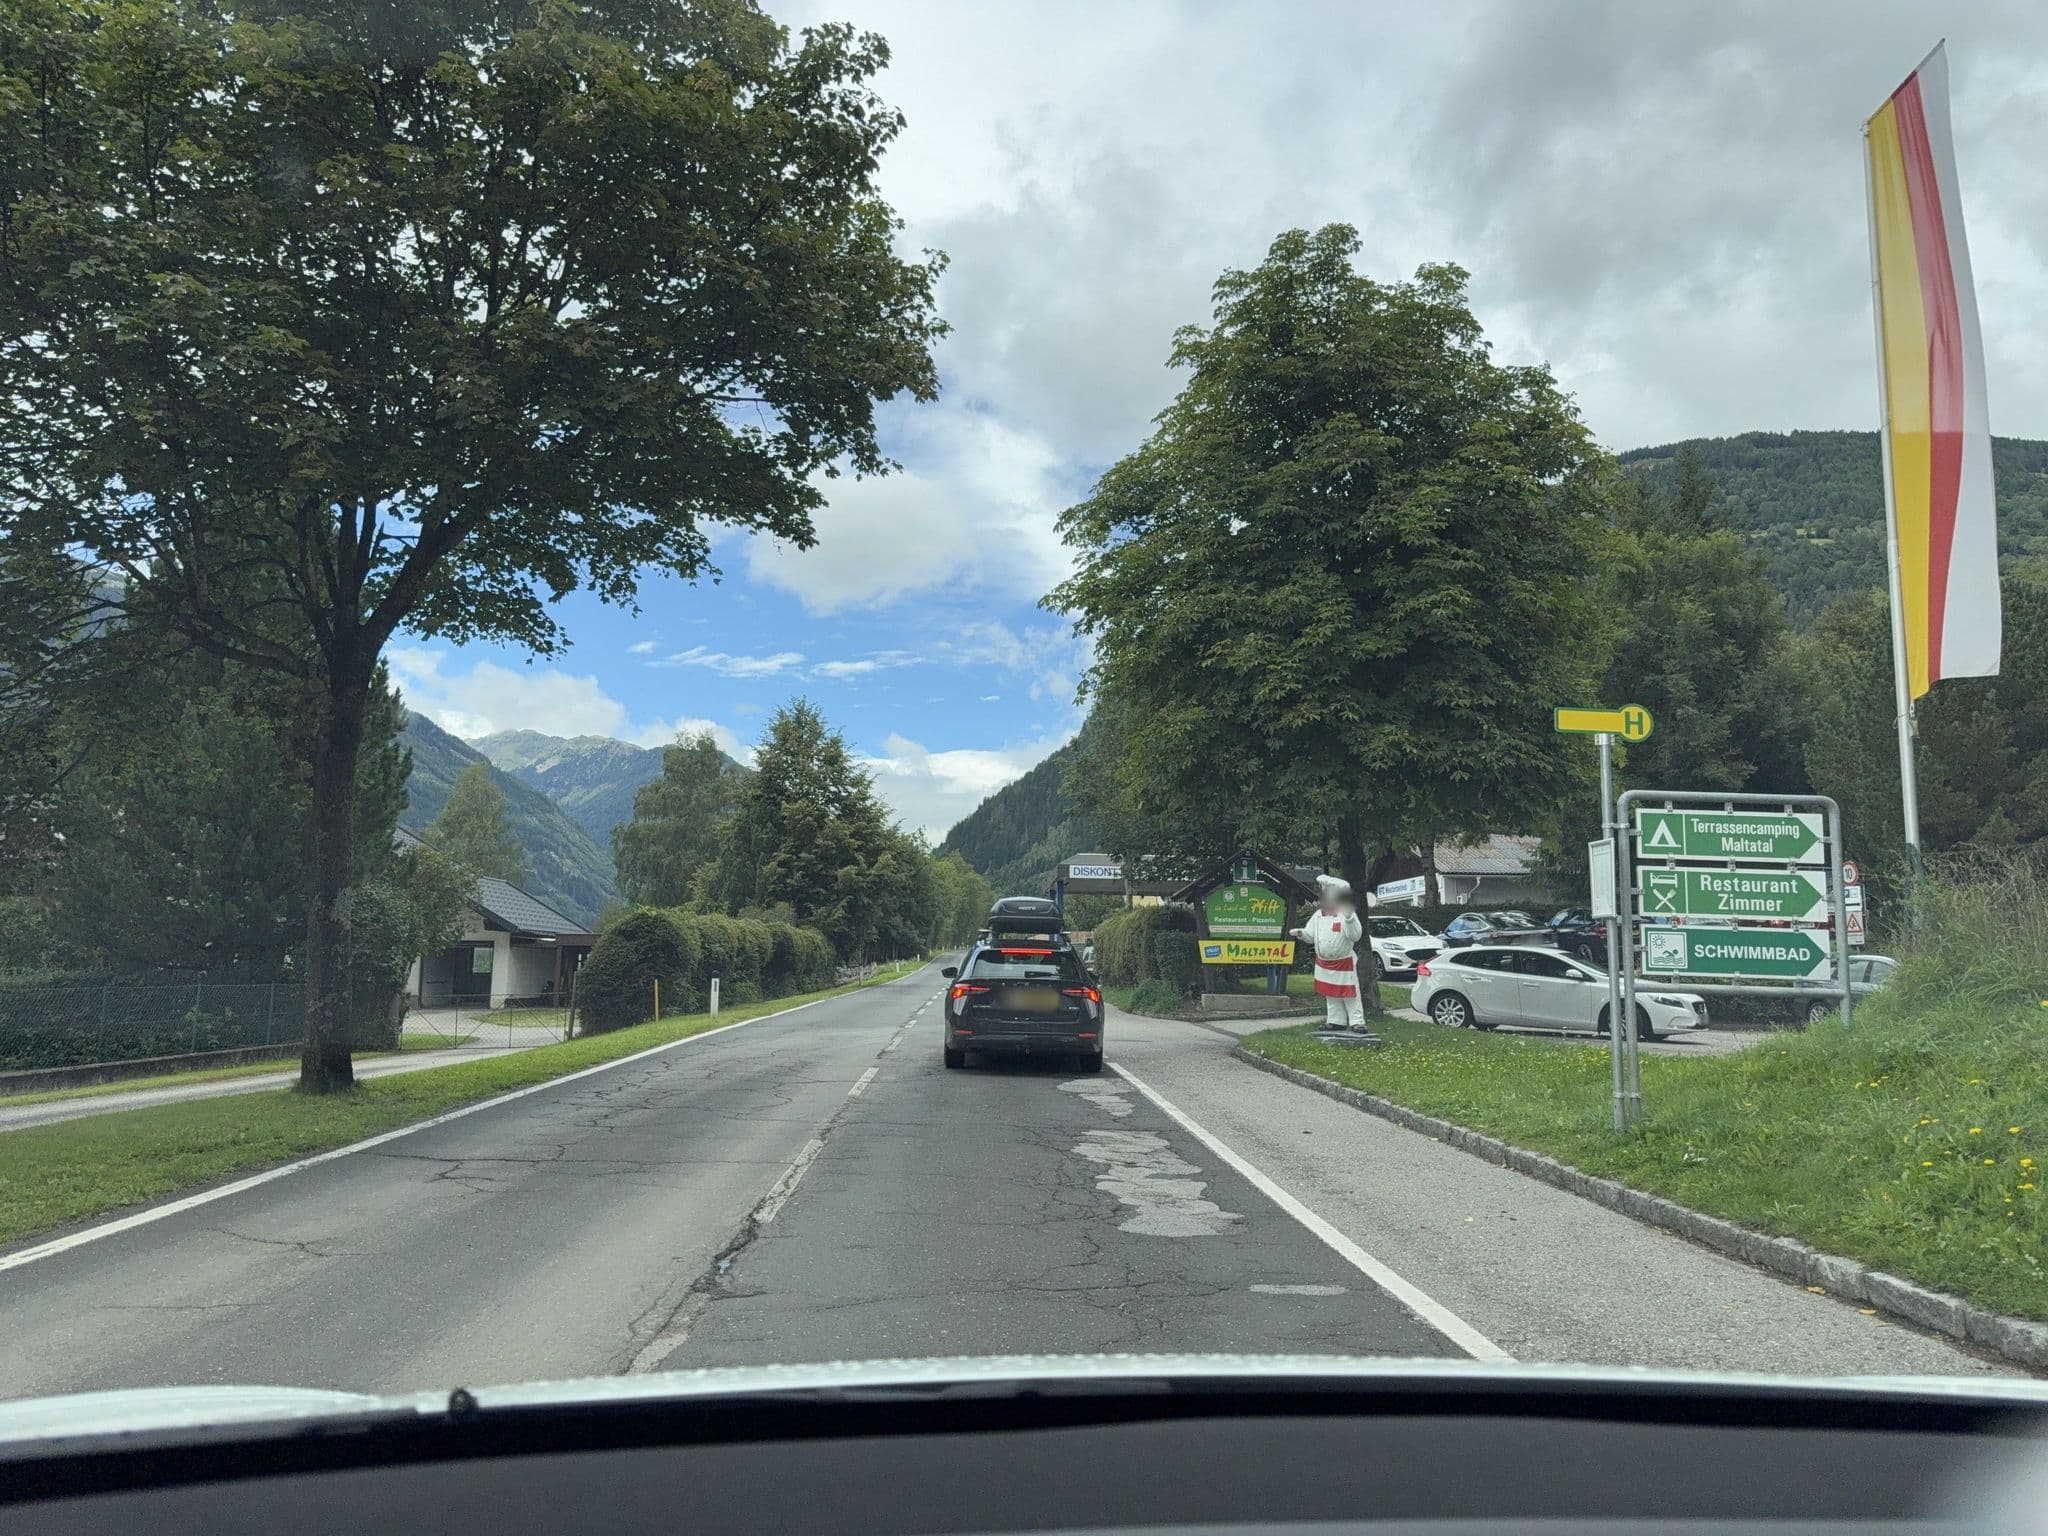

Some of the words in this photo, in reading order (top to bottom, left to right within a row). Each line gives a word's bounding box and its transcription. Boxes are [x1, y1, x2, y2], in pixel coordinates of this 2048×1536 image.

[1624, 711, 1644, 736] H
[1690, 817, 1801, 839] Terrassencamping
[1721, 837, 1774, 854] Maltatal
[1844, 868, 1853, 880] 10
[1699, 874, 1798, 895] Restaurant
[1717, 893, 1783, 913] Zimmer
[1694, 944, 1811, 962] SCHWIMMBAD
